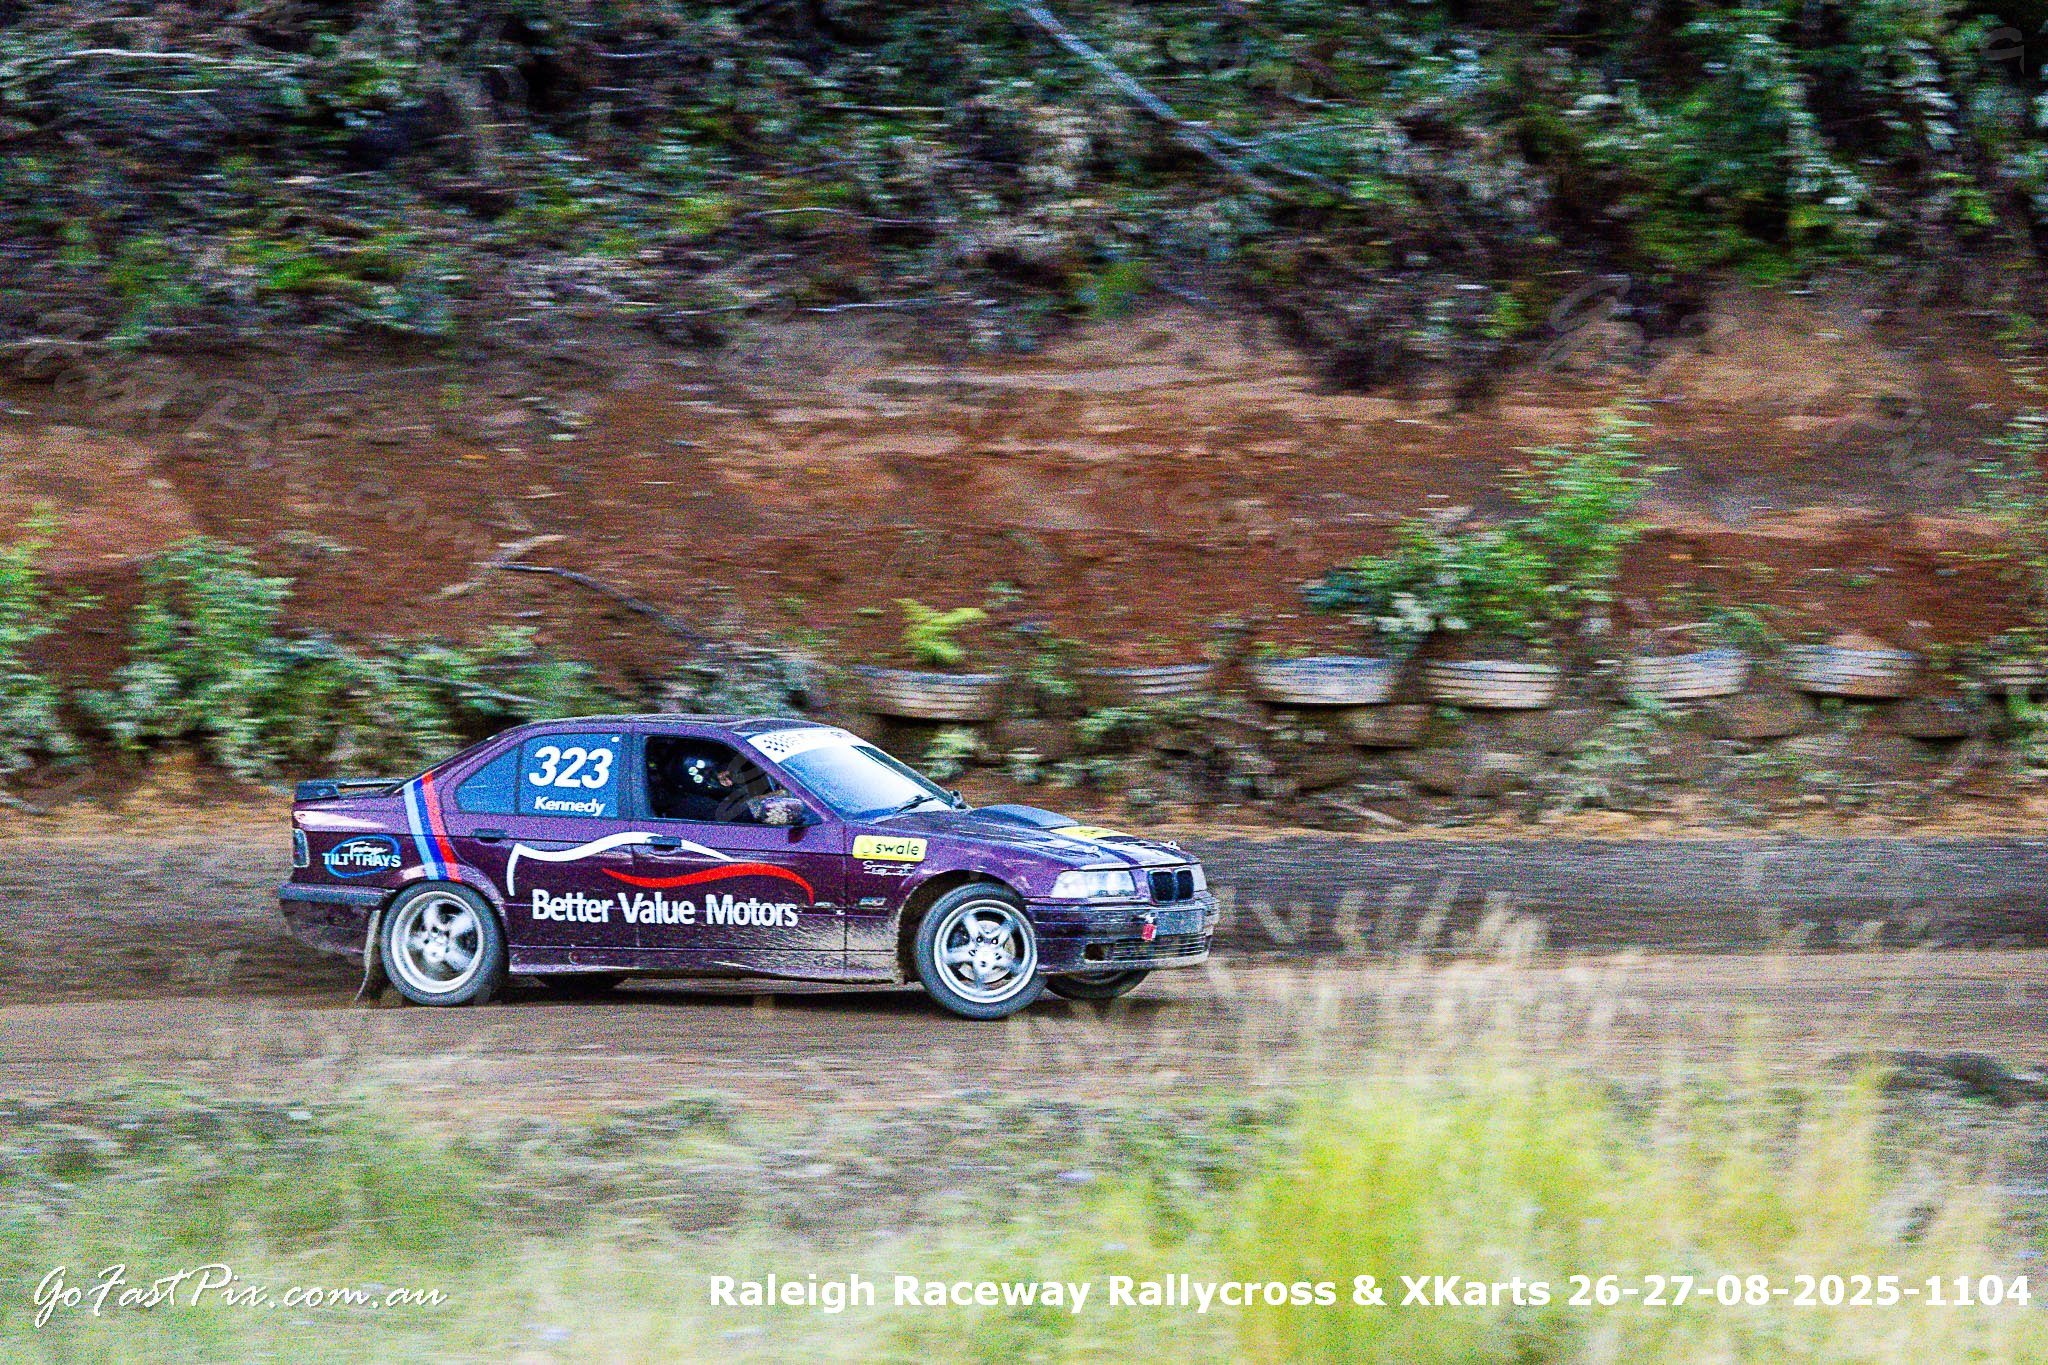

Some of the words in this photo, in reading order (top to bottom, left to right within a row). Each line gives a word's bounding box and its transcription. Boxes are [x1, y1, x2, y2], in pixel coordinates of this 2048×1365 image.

[529, 745, 614, 789] 323
[533, 795, 606, 817] Kennedy
[322, 852, 350, 866] TILT
[353, 853, 402, 868] TRAYS
[532, 888, 614, 923] Better
[617, 891, 697, 925] Value
[705, 893, 800, 927] Motors
